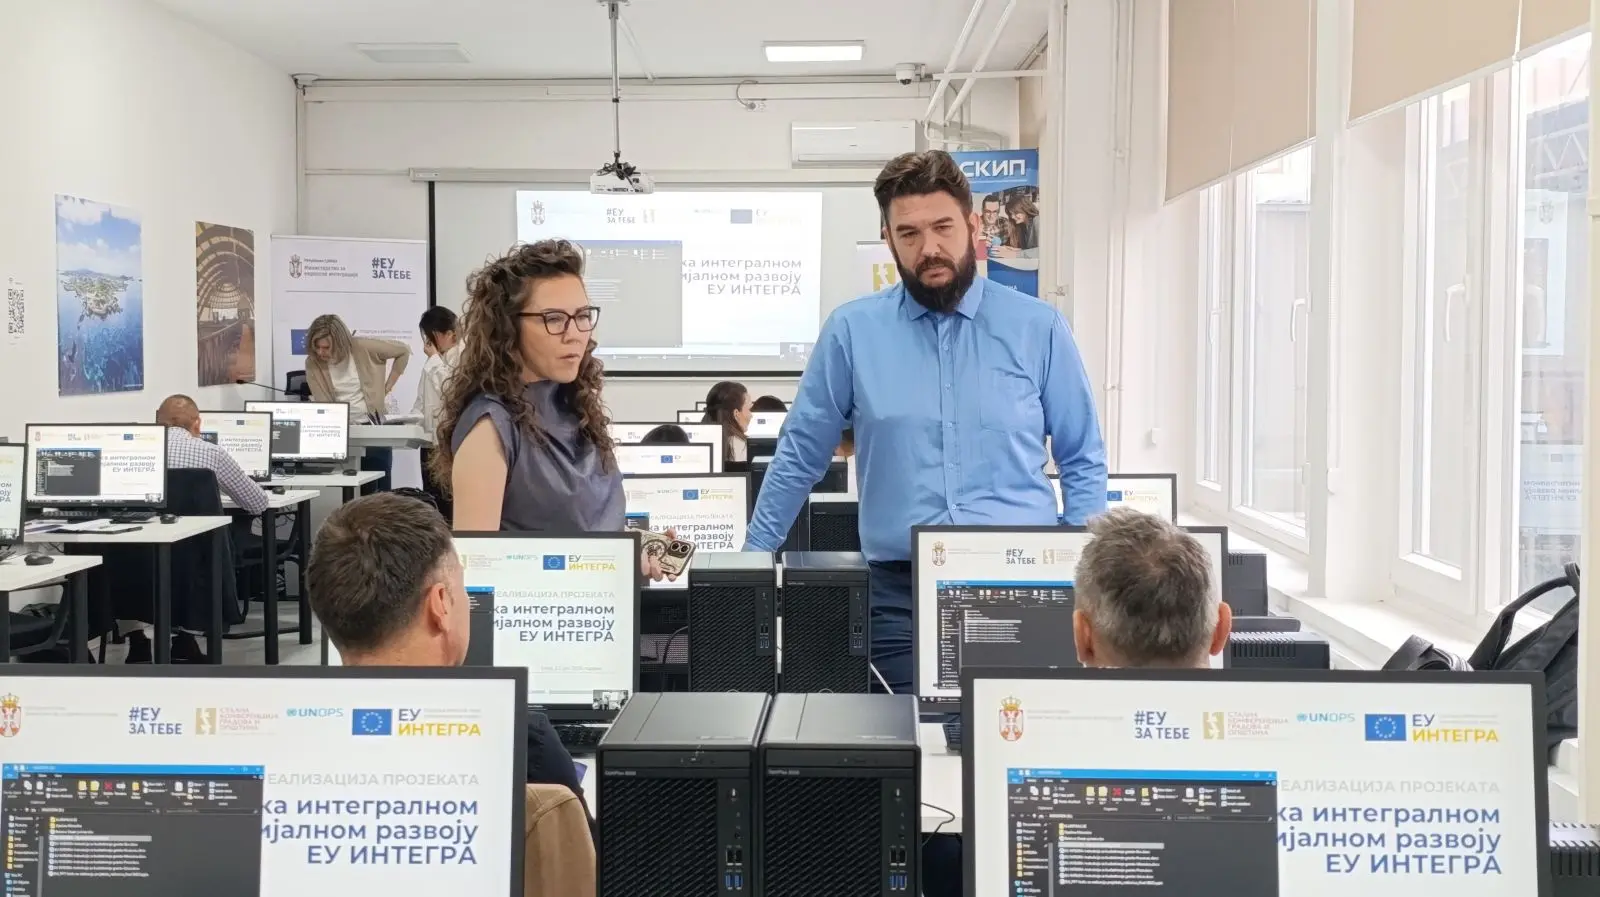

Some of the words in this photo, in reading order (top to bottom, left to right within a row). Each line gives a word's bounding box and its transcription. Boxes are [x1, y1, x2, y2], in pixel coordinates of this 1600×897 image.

[959, 160, 1026, 178] СКИП
[371, 257, 396, 269] #ЕУ
[701, 259, 802, 271] интегралном
[372, 270, 386, 279] ЗА
[388, 270, 412, 280] ТЕБЕ
[744, 271, 802, 285] развоју
[707, 284, 727, 296] ЕУ
[731, 284, 802, 296] ИНТЕГРА
[693, 531, 735, 542] развоју
[1006, 549, 1024, 557] #ЕУ
[568, 563, 616, 571] ИНТЕГРА
[1006, 557, 1016, 565] ЗА
[1017, 557, 1037, 565] ТЕБЕ
[513, 605, 615, 616] интегралном
[557, 616, 615, 631] развоју
[519, 631, 539, 642] ЕУ
[543, 631, 615, 642] ИНТЕГРА
[128, 706, 161, 722] #ЕУ
[298, 707, 344, 717] UNOPS
[398, 708, 421, 722] ЕУ
[1134, 711, 1167, 726] #ЕУ
[1309, 713, 1356, 723] UNOPS
[1412, 714, 1436, 728] ЕУ
[128, 722, 146, 735] ЗА
[149, 722, 183, 736] ТЕБЕ
[398, 723, 482, 737] ИНТЕГРА
[1134, 727, 1153, 740] ЗА
[1156, 727, 1191, 740] ТЕБЕ
[1412, 729, 1499, 743] ИНТЕГРА
[268, 774, 379, 787] ЕАЛИЗАЦИЈА
[383, 774, 479, 786] ПРОЈЕКАТА
[1400, 781, 1500, 793] ПРОЈЕКАТА
[297, 800, 478, 819] интегралном
[1313, 806, 1500, 828] интегралном
[376, 819, 479, 845] развоју
[1396, 827, 1502, 854] развоју
[307, 845, 342, 864] ЕУ
[350, 845, 478, 865] ИНТЕГРА
[1326, 854, 1361, 873] ЕУ
[1370, 854, 1502, 875] ИНТЕГРА
